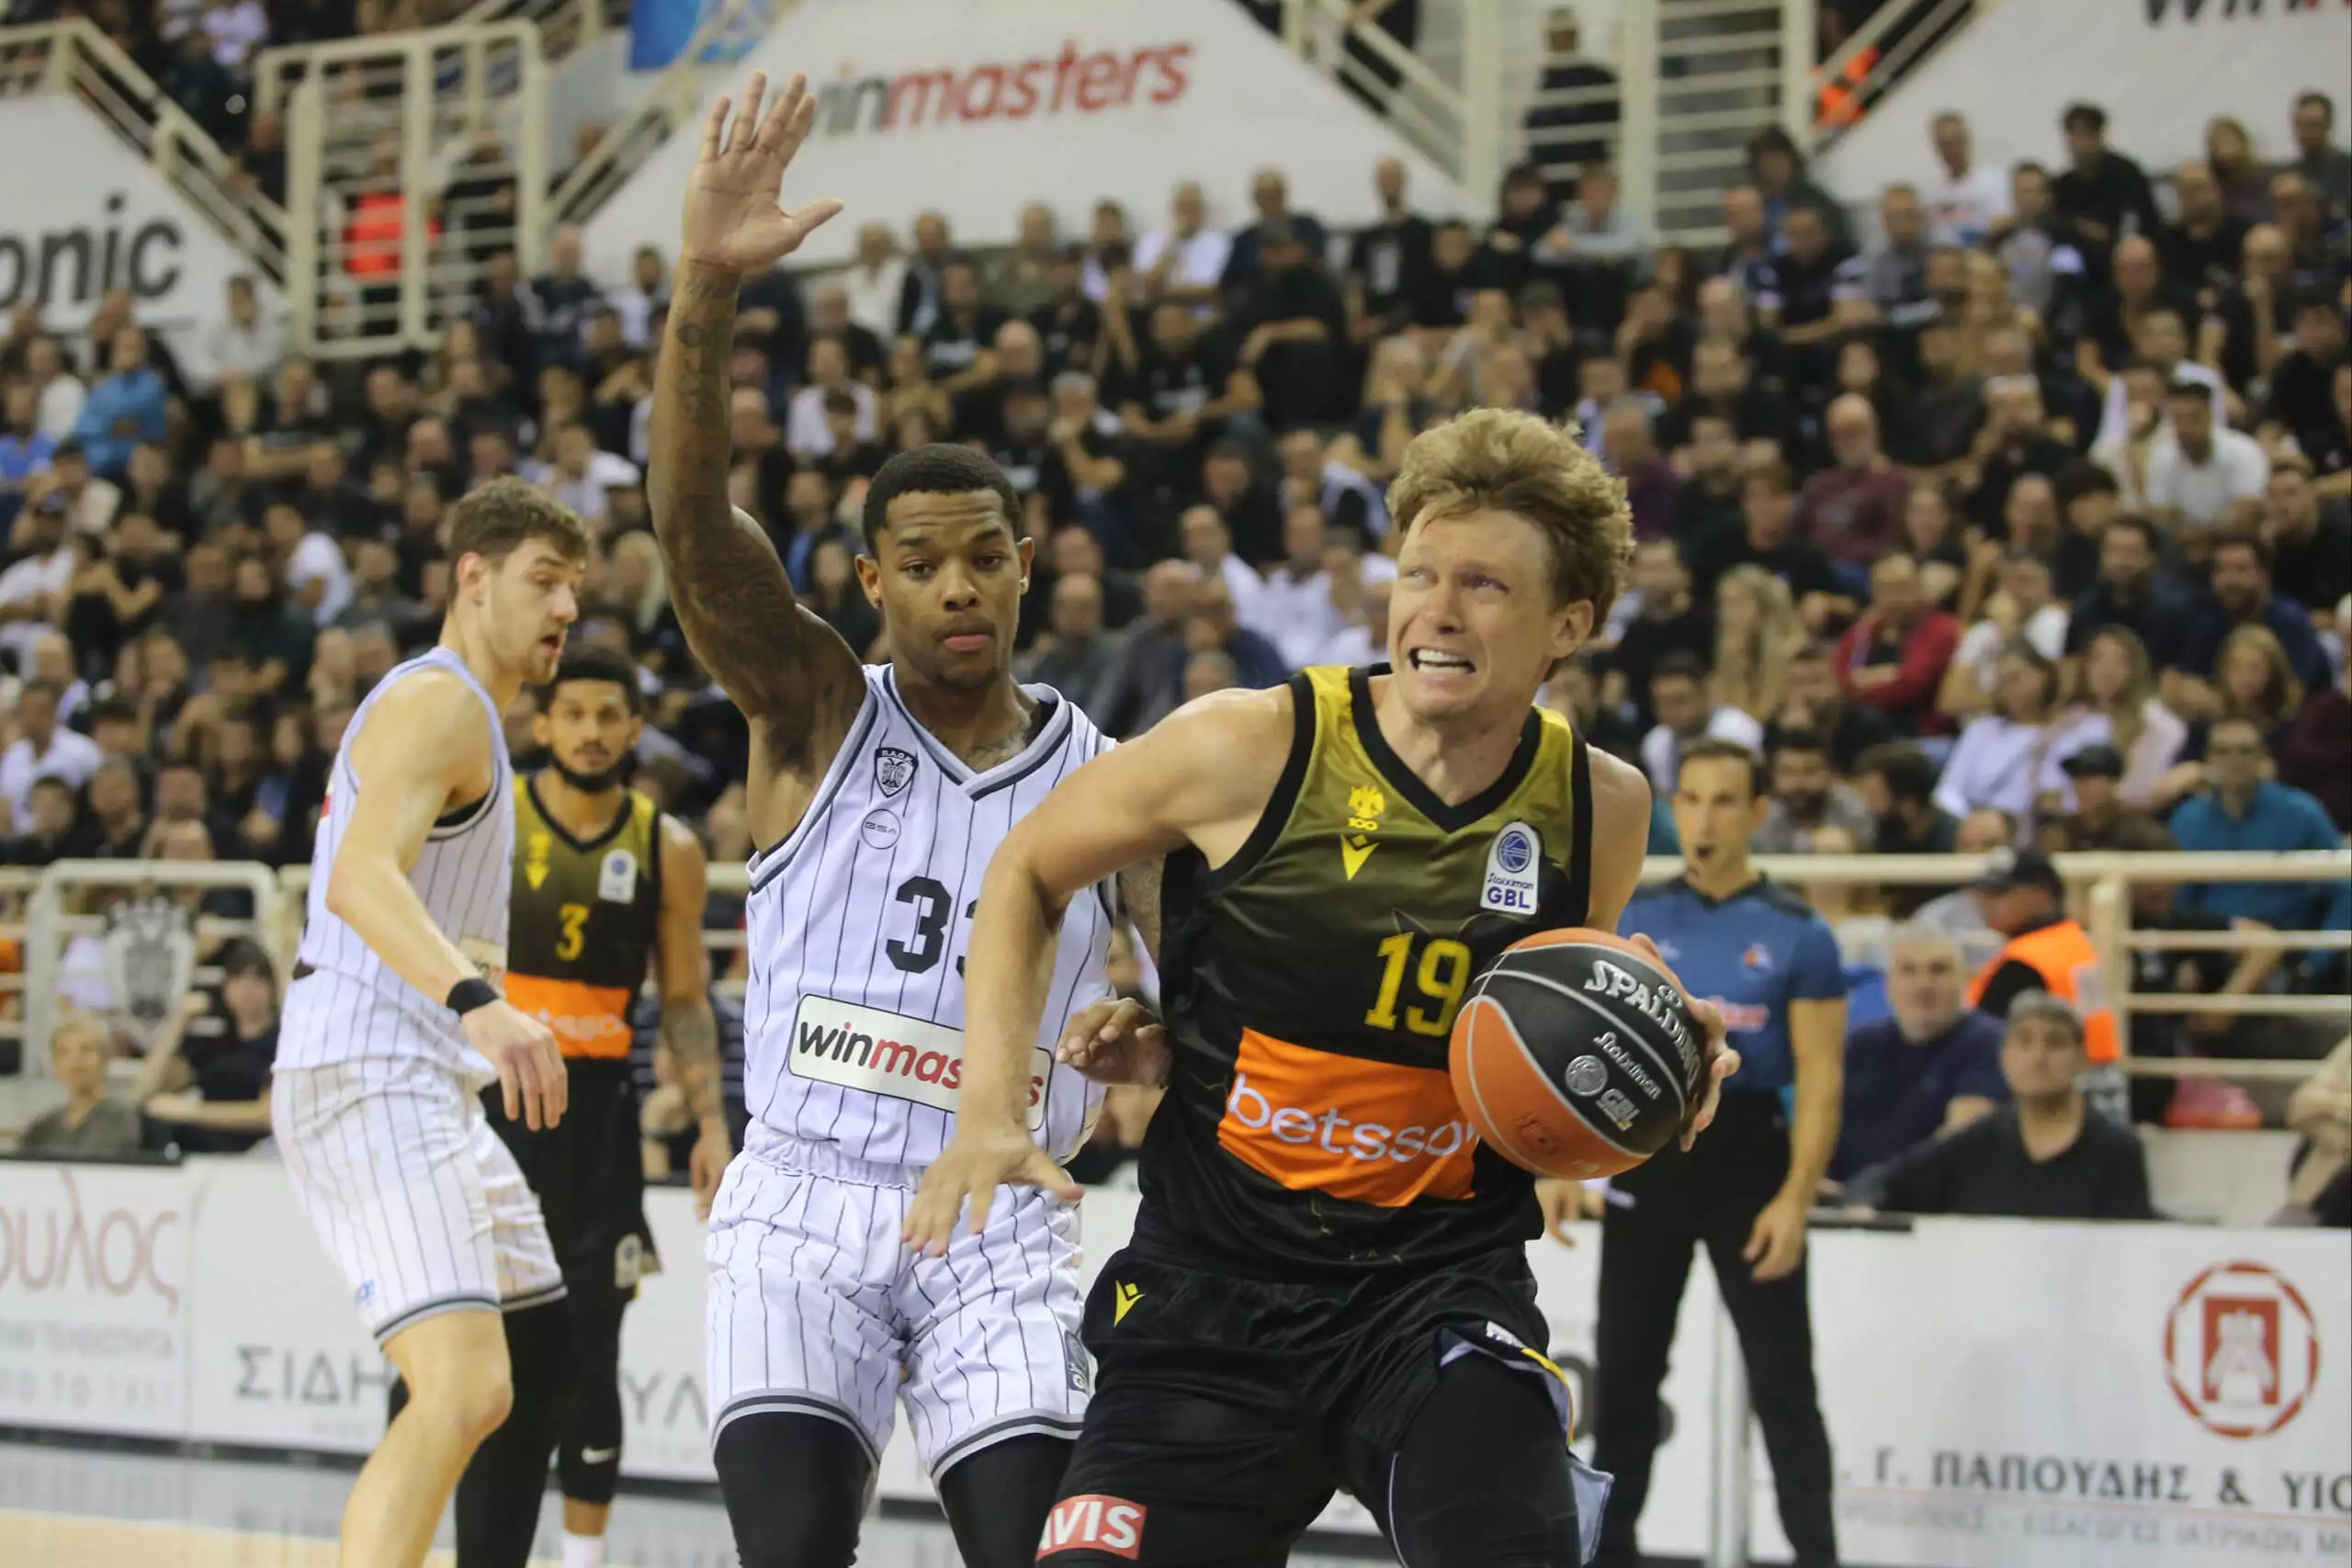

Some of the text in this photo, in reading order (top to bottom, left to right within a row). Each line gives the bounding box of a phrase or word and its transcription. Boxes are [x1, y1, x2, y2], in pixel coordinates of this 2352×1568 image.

[556, 903, 591, 961] 3
[886, 875, 978, 978] 3
[1487, 886, 1531, 908] GBL
[1364, 931, 1472, 1037] 19
[799, 1021, 1045, 1108] winmass
[1227, 1073, 1476, 1164] betsso
[1932, 1450, 2190, 1504] ΠΑΠΟΥΔΗΣ
[2219, 1467, 2254, 1506] &
